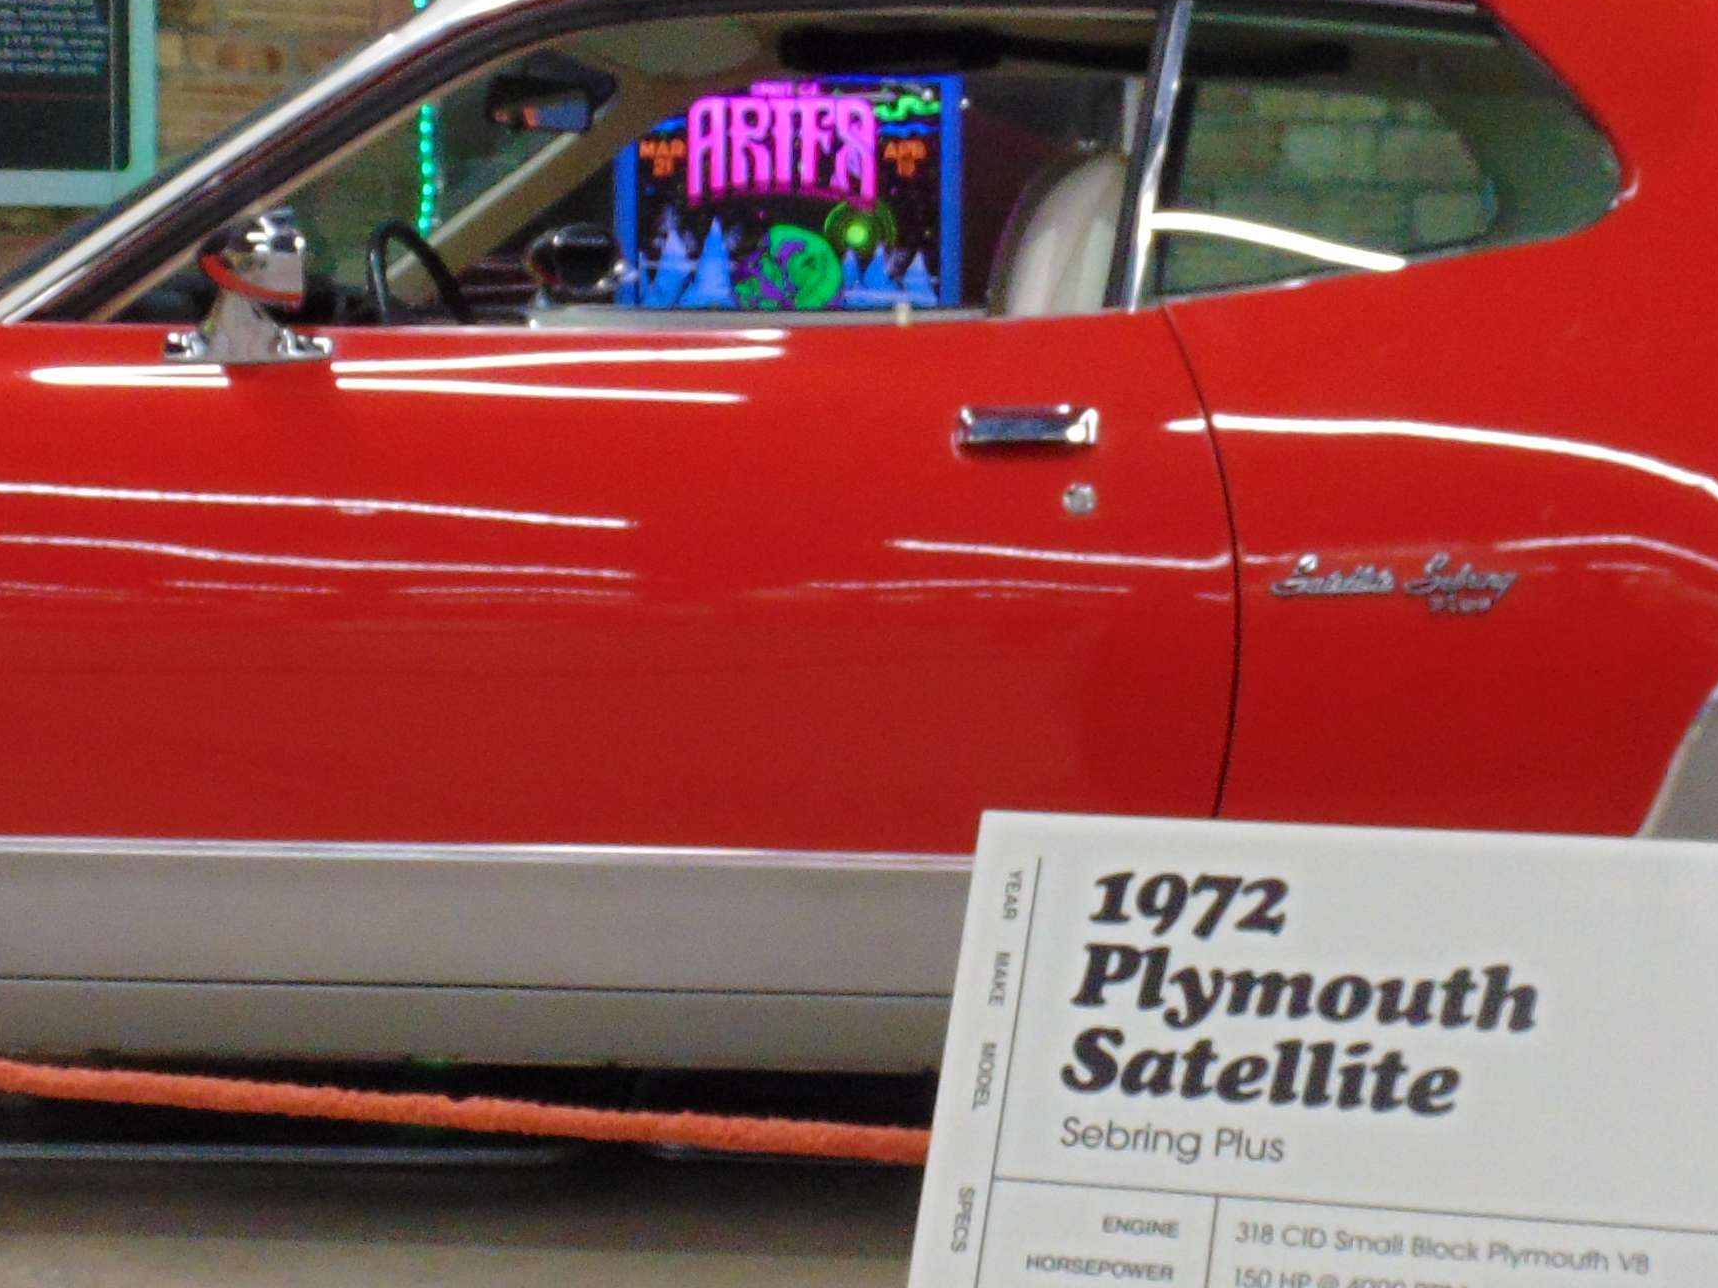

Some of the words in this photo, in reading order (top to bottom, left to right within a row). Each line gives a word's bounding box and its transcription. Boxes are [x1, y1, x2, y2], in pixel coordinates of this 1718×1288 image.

[1000, 868, 1024, 922] YEAR
[1089, 871, 1290, 941] 1972
[1070, 942, 1540, 1032] Plymouth
[970, 1040, 998, 1111] MODEL
[1059, 1026, 1463, 1117] Satellite
[1060, 1115, 1202, 1165] Sebring
[1214, 1127, 1285, 1163] Plus
[949, 1184, 976, 1254] SPECS
[1100, 1214, 1180, 1239] ENGINE
[1234, 1220, 1274, 1246] 318
[1280, 1224, 1327, 1250] CID
[1333, 1228, 1404, 1256] Small
[1409, 1234, 1479, 1261] Block
[1486, 1240, 1609, 1271] Plymouth
[1617, 1251, 1650, 1275] V8
[1025, 1253, 1174, 1281] HORSEPOWER
